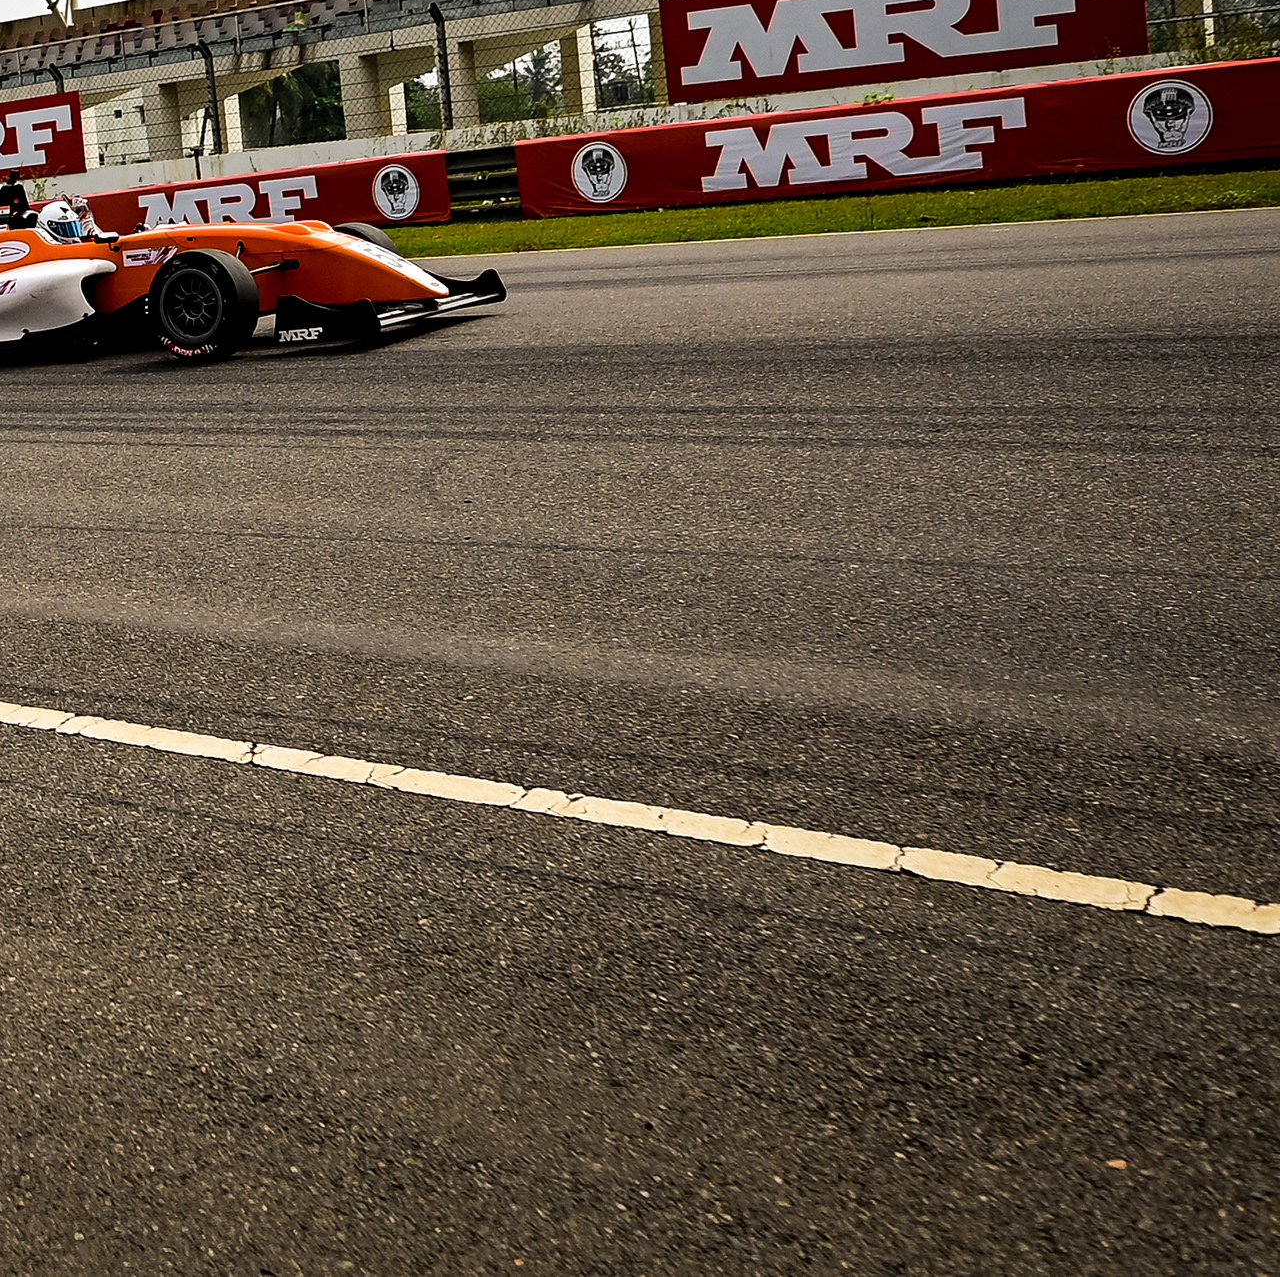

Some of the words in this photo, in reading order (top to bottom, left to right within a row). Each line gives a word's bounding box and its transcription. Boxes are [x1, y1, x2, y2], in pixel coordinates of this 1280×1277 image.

[701, 97, 1027, 193] MRF
[138, 175, 318, 225] MRF
[278, 327, 323, 342] MRF
